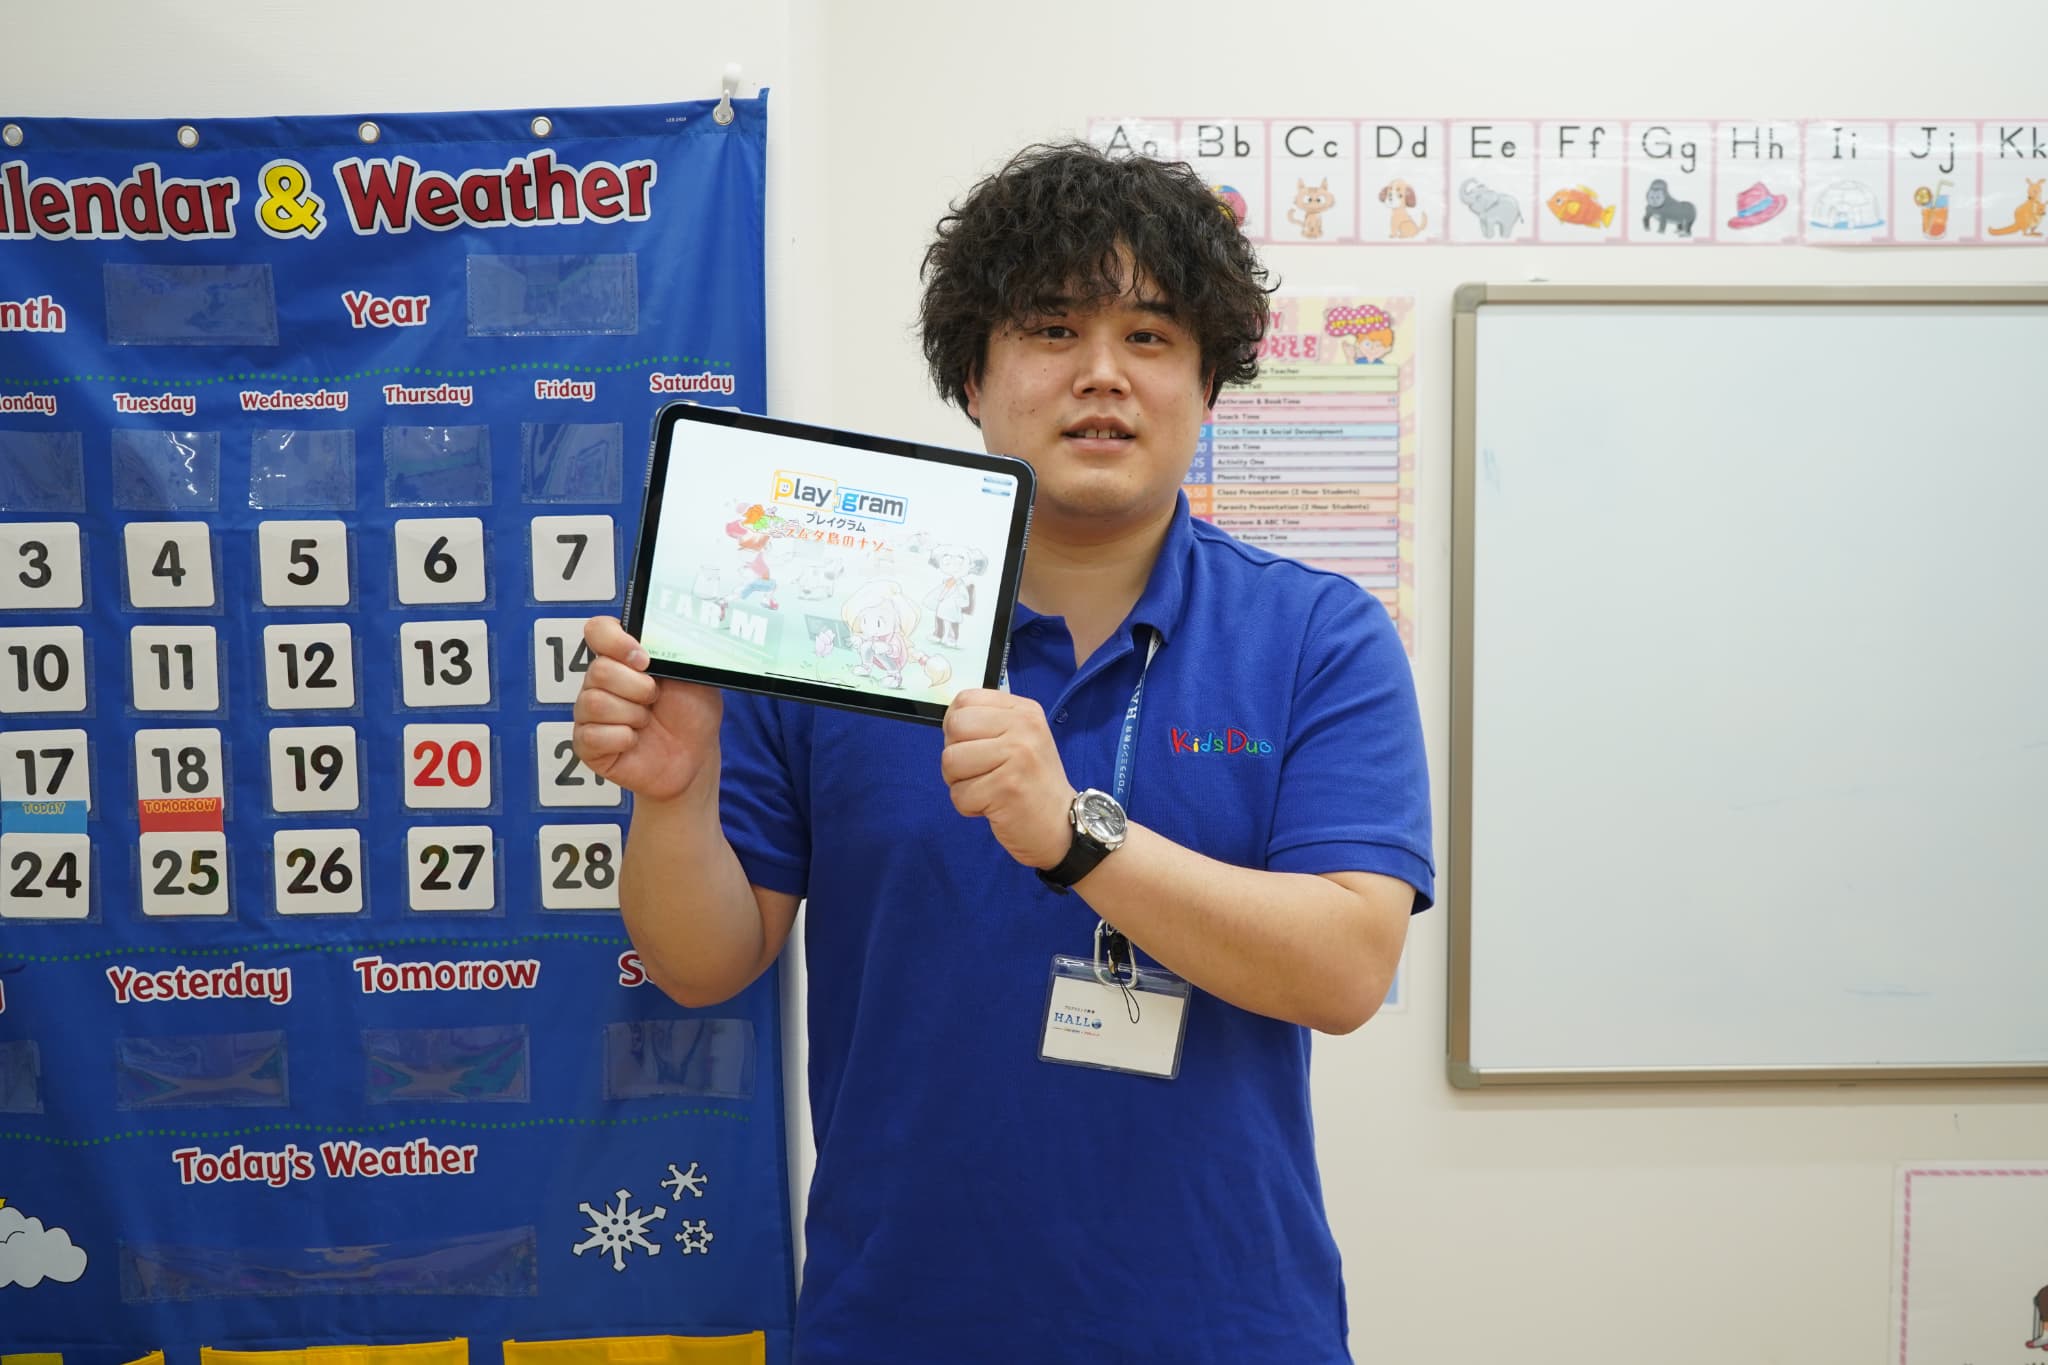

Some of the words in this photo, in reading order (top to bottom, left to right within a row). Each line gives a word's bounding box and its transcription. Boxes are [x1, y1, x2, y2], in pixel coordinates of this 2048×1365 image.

[1198, 125, 1250, 158] Bb
[1285, 125, 1339, 158] Cc
[1376, 125, 1428, 158] Dd
[1471, 126, 1517, 158] Ee
[1557, 126, 1606, 158] Ff
[1641, 126, 1697, 173] Gg
[1731, 127, 1784, 159] Hh
[1909, 126, 1956, 174] Jj
[258, 161, 324, 237] &
[336, 151, 654, 232] Weather
[343, 292, 430, 327] Year
[0, 393, 56, 415] onday
[114, 393, 195, 415] Tuesday
[240, 391, 348, 411] Wednesday
[383, 385, 472, 405] Thursday
[535, 380, 595, 401] Friday
[650, 373, 733, 394] Saturday
[1216, 397, 1254, 405] Bathroom
[1282, 397, 1301, 405] Time
[1295, 428, 1343, 436] Development
[1217, 458, 1248, 467] Activity
[1249, 458, 1265, 466] One
[1248, 473, 1281, 482] Program
[773, 477, 833, 508] play
[841, 492, 904, 518] gram
[1216, 488, 1238, 496] Class
[1239, 488, 1289, 496] Presentation
[1301, 488, 1319, 496] Hour
[1322, 488, 1360, 496] Students)
[1216, 503, 1247, 511] Parents
[1249, 503, 1299, 511] Presentation
[1311, 503, 1329, 511] Hour
[1331, 503, 1370, 511] Students)
[805, 511, 867, 534] プレイグラム
[1216, 518, 1254, 526] Bathroom
[1256, 518, 1262, 526] &
[1264, 518, 1279, 526] ABC
[1282, 518, 1300, 526] Time
[1270, 533, 1288, 541] Time
[18, 540, 53, 589] 3
[151, 540, 187, 588] 4
[287, 538, 320, 586] 5
[423, 535, 458, 584] 6
[556, 534, 588, 581] 7
[7, 643, 70, 693] 10
[149, 644, 194, 691] 11
[277, 641, 338, 690] 12
[413, 638, 473, 687] 13
[1170, 727, 1273, 754] KidsDuo
[15, 747, 75, 796] 17
[151, 746, 210, 794] 18
[285, 744, 344, 792] 19
[412, 740, 483, 788] 20
[22, 802, 66, 815] TODAY
[144, 799, 217, 814] TOMORROW
[9, 850, 83, 899] 24
[152, 849, 220, 896] 25
[286, 846, 353, 895] 26
[419, 844, 486, 891] 27
[551, 842, 615, 890] 28
[109, 964, 291, 1003] Yesterday
[355, 957, 539, 992] Tomorrow
[174, 1148, 313, 1186] Today's
[322, 1140, 477, 1176] Weather
